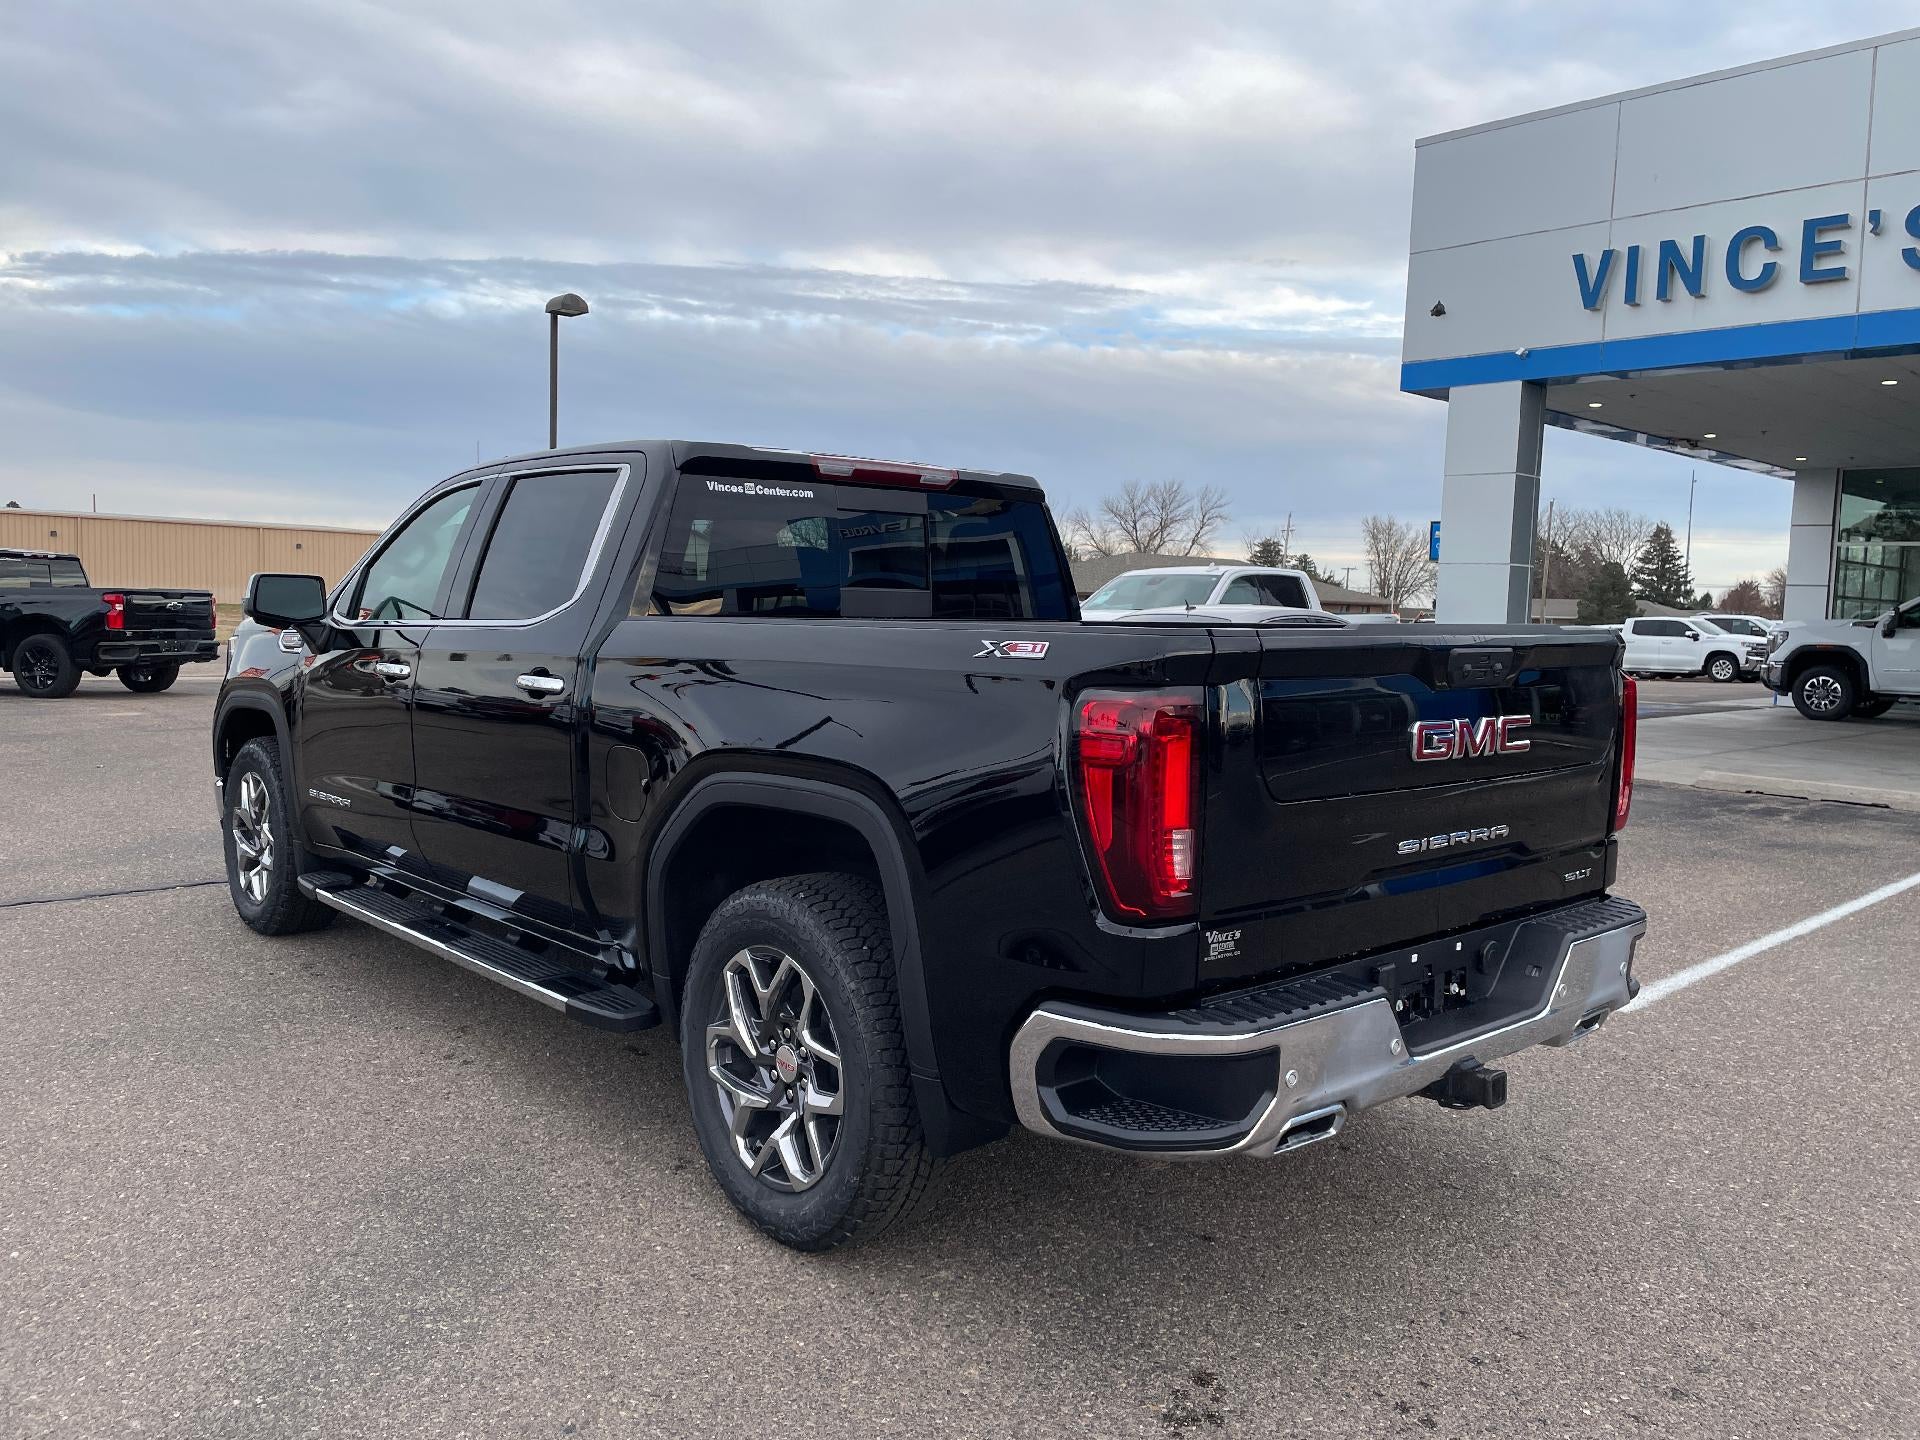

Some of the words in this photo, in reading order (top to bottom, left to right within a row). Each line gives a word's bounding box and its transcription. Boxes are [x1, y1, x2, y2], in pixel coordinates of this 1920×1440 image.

[1408, 714, 1532, 762] GMC
[308, 788, 351, 807] SIERRA
[1396, 824, 1510, 855] SIERRA
[1563, 867, 1593, 882] SLT
